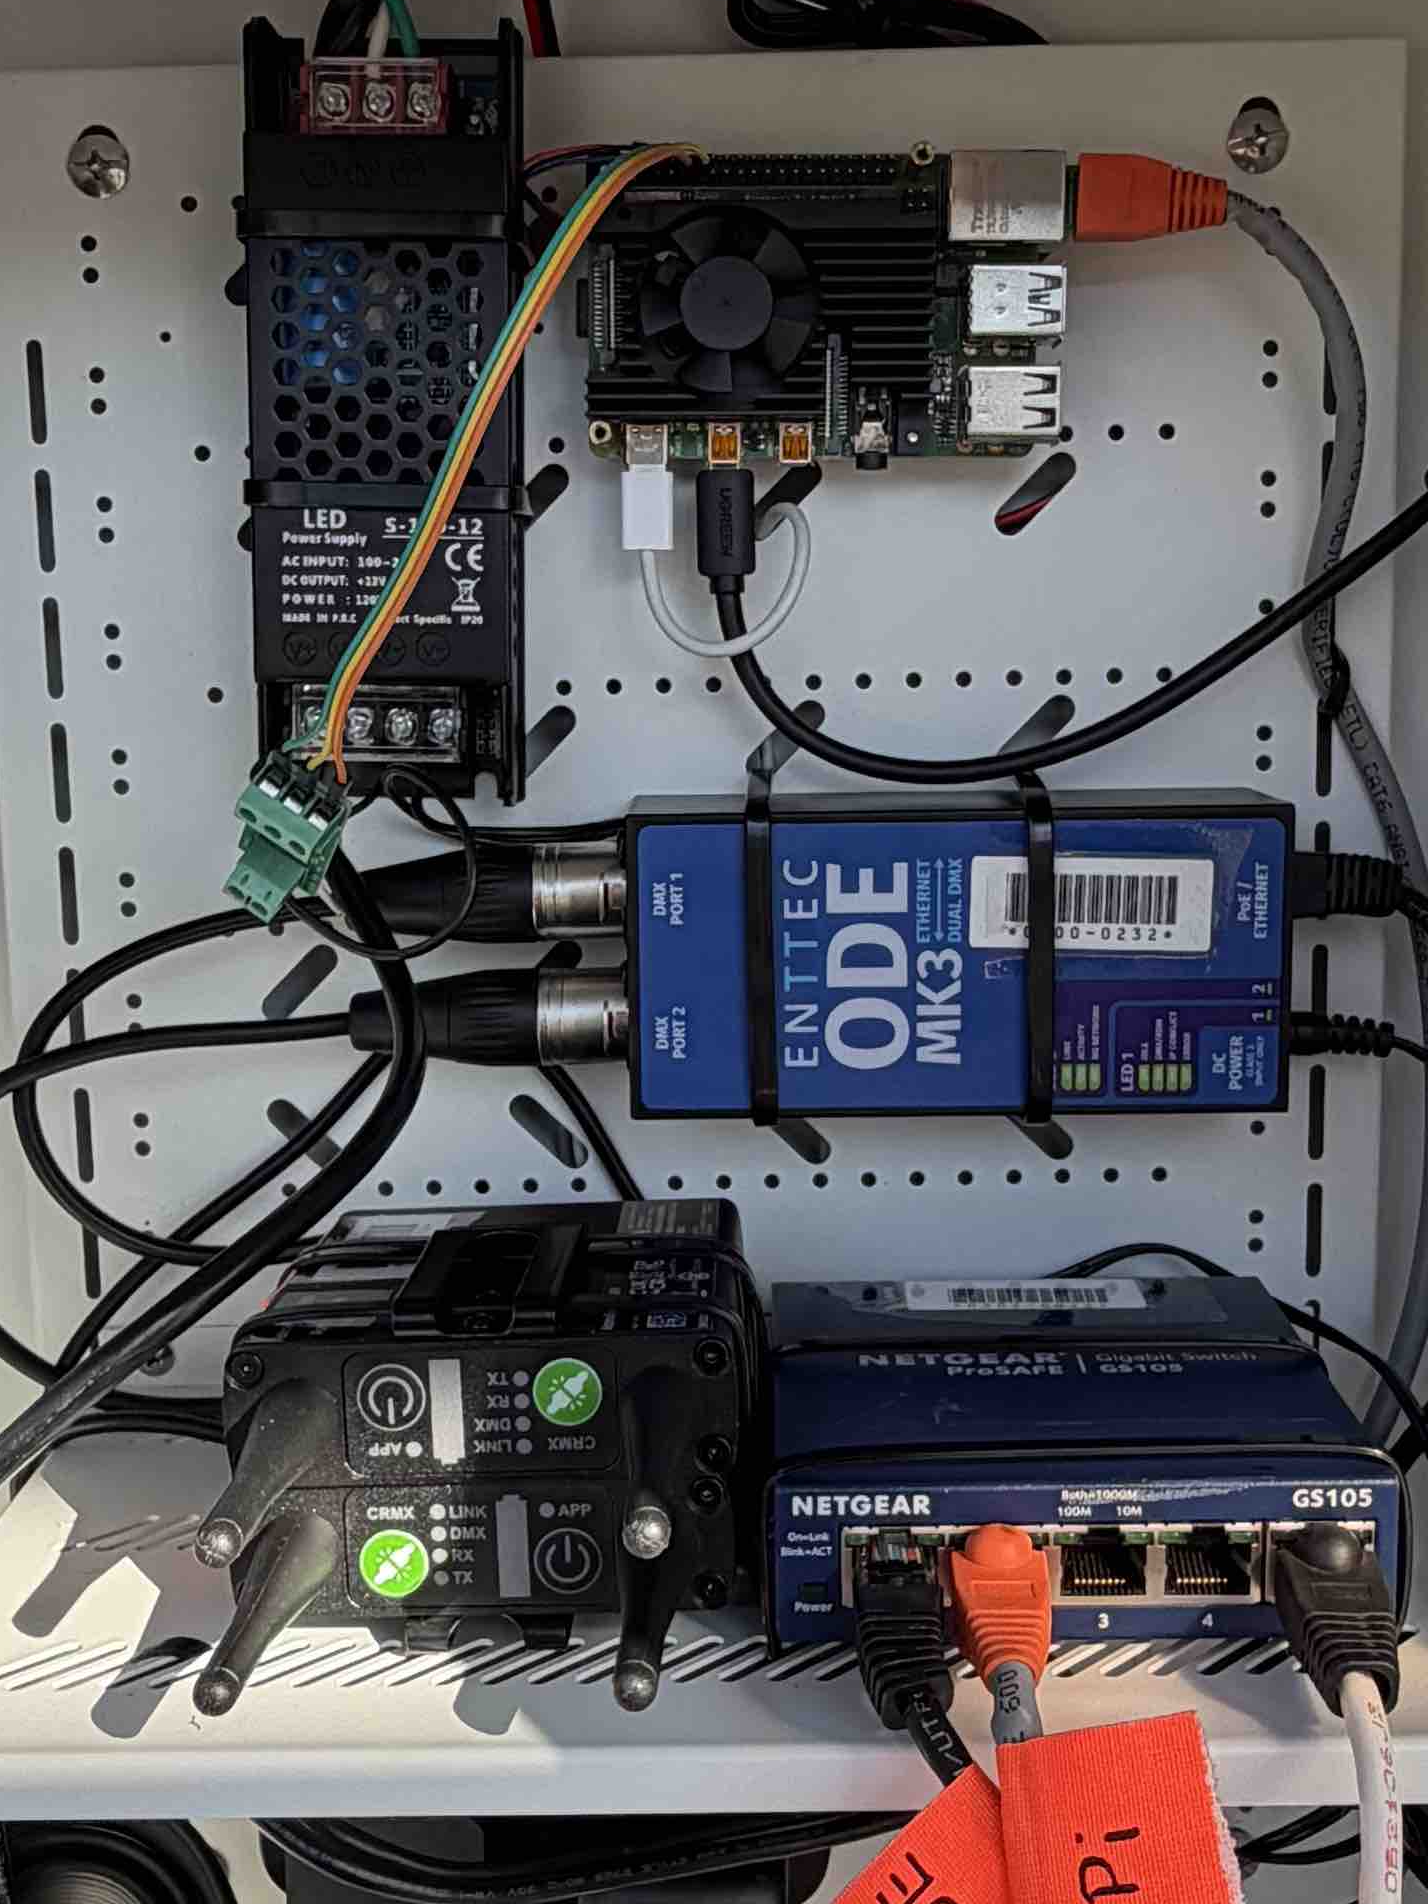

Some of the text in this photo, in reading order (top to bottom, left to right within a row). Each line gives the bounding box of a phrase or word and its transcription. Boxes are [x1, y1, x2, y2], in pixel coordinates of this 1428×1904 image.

[304, 509, 347, 529] LED
[385, 517, 483, 535] S-1-12
[282, 532, 367, 546] Power Supply
[282, 556, 399, 568] AC INPUT: 100-2
[282, 575, 298, 586] DC
[300, 575, 349, 586] OUTPUT:
[282, 594, 335, 605] POWER
[282, 613, 311, 623] MADE
[316, 613, 329, 623] IN
[461, 615, 484, 625] IP20
[653, 883, 667, 916] DMX
[670, 872, 685, 925] PORT 1
[916, 859, 932, 944] ETHERNET
[947, 858, 962, 943] DUAL DMX
[1253, 862, 1269, 939] ETHERNET
[1237, 894, 1253, 922] PoE
[1023, 927, 1157, 942] 000-0232
[783, 859, 819, 1067] ENTTEC
[824, 862, 910, 1070] ODE
[916, 948, 963, 1065] MK3
[655, 1016, 669, 1050] DMX
[672, 1006, 686, 1059] PORT 2
[1212, 1052, 1226, 1074] DC
[1229, 1035, 1244, 1091] POWER
[1120, 1052, 1134, 1092] LED 1
[858, 1349, 1260, 1367] NETGEAR Gigabit Switch
[946, 1363, 1182, 1376] ProSAFE GS105
[487, 1372, 509, 1386] TX
[487, 1395, 510, 1408] RX
[475, 1419, 511, 1432] DMX
[369, 1442, 402, 1456] APP
[474, 1439, 512, 1453] LINK
[548, 1436, 596, 1451] CRMX
[792, 1495, 931, 1516] NETGEAR
[1292, 1488, 1373, 1508] GS105
[367, 1506, 415, 1520] CRMX
[449, 1505, 487, 1519] LINK
[557, 1504, 592, 1517] APP
[1057, 1506, 1142, 1517] 100M 10M
[450, 1526, 487, 1539] DMX
[452, 1548, 474, 1562] RX
[453, 1571, 474, 1585] TX
[794, 1601, 833, 1613] Power
[1097, 1613, 1109, 1628] 3
[1201, 1613, 1213, 1627] 4
[1078, 1826, 1141, 1904] Pi
